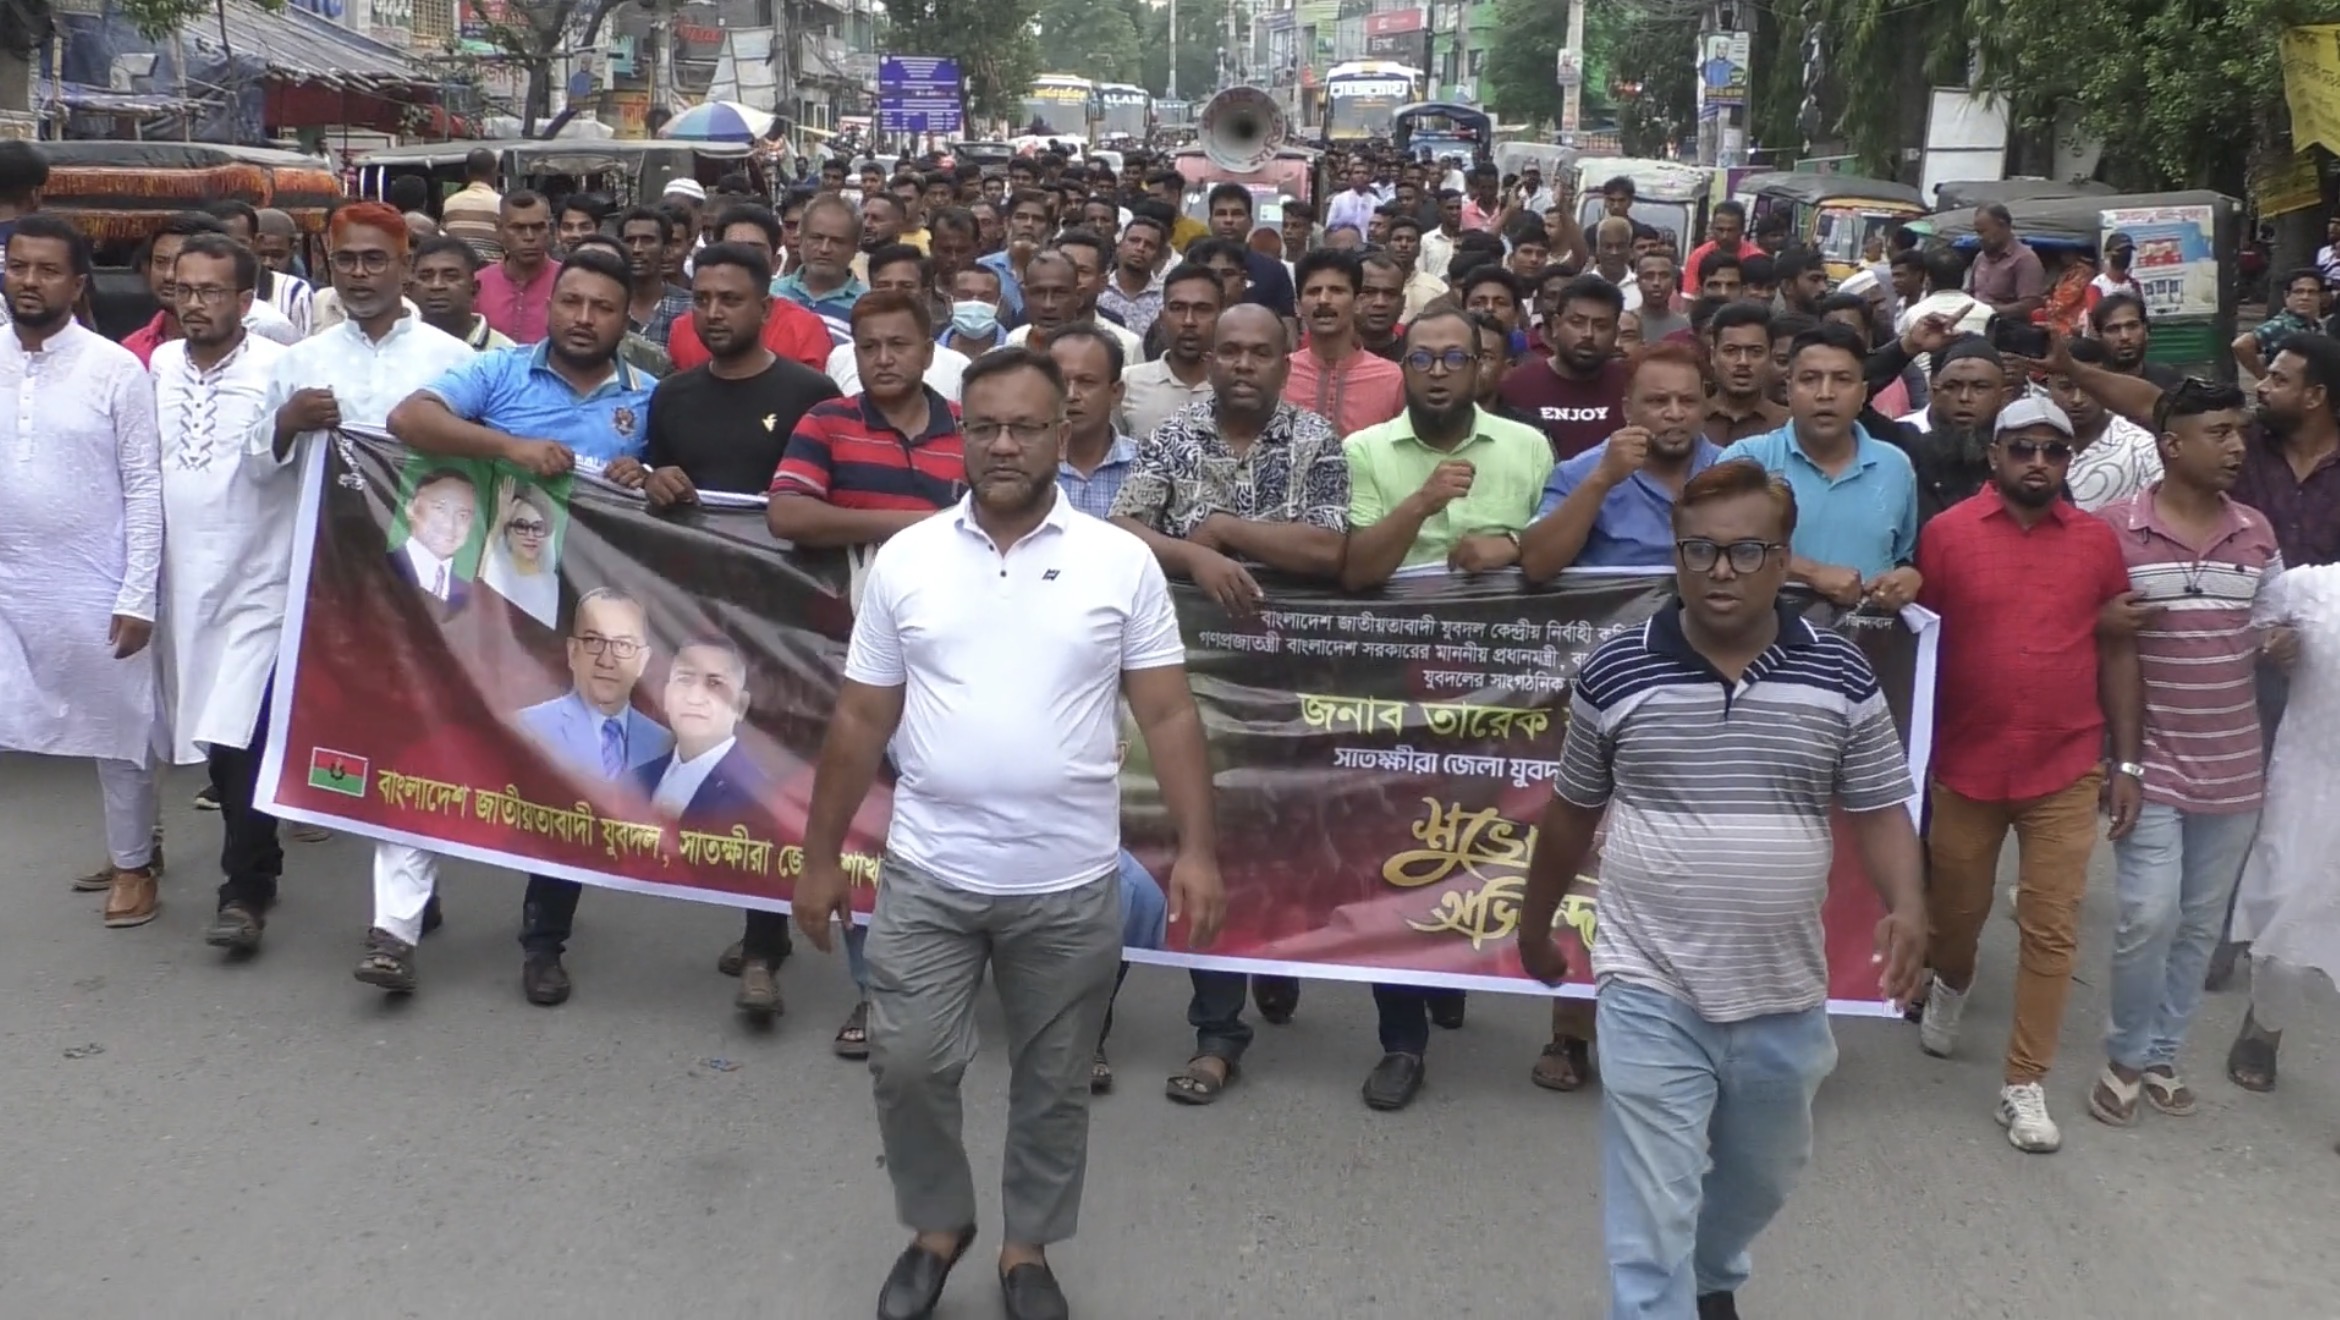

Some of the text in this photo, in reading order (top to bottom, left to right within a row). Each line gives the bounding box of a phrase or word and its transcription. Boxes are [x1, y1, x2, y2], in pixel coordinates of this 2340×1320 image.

[1539, 406, 1609, 421] ENJOY
[1260, 610, 1332, 631] বাংলাদেশ
[1337, 611, 1436, 637] জাতীয়তাবাদী
[1440, 621, 1487, 641] যুবদল
[1490, 618, 1541, 641] কেন্দ্রীয়
[1546, 620, 1593, 644] নির্বাহী
[1286, 637, 1358, 658] বাংলাদেশ
[1362, 642, 1431, 660] সরকারের
[1435, 641, 1489, 664] মাননীয়
[1422, 669, 1484, 690] যুবদলের
[1490, 668, 1566, 693] সাংগঠনিক
[1296, 693, 1410, 737] জনাব
[1416, 700, 1552, 741] তারেক
[1334, 744, 1560, 788] সাতক্ষীরা জেলা যুবদ
[377, 768, 470, 819] বাংলাদেশ
[475, 783, 596, 847] জাতীয়তাবাদী
[679, 823, 774, 877] সাতক্ষীরা
